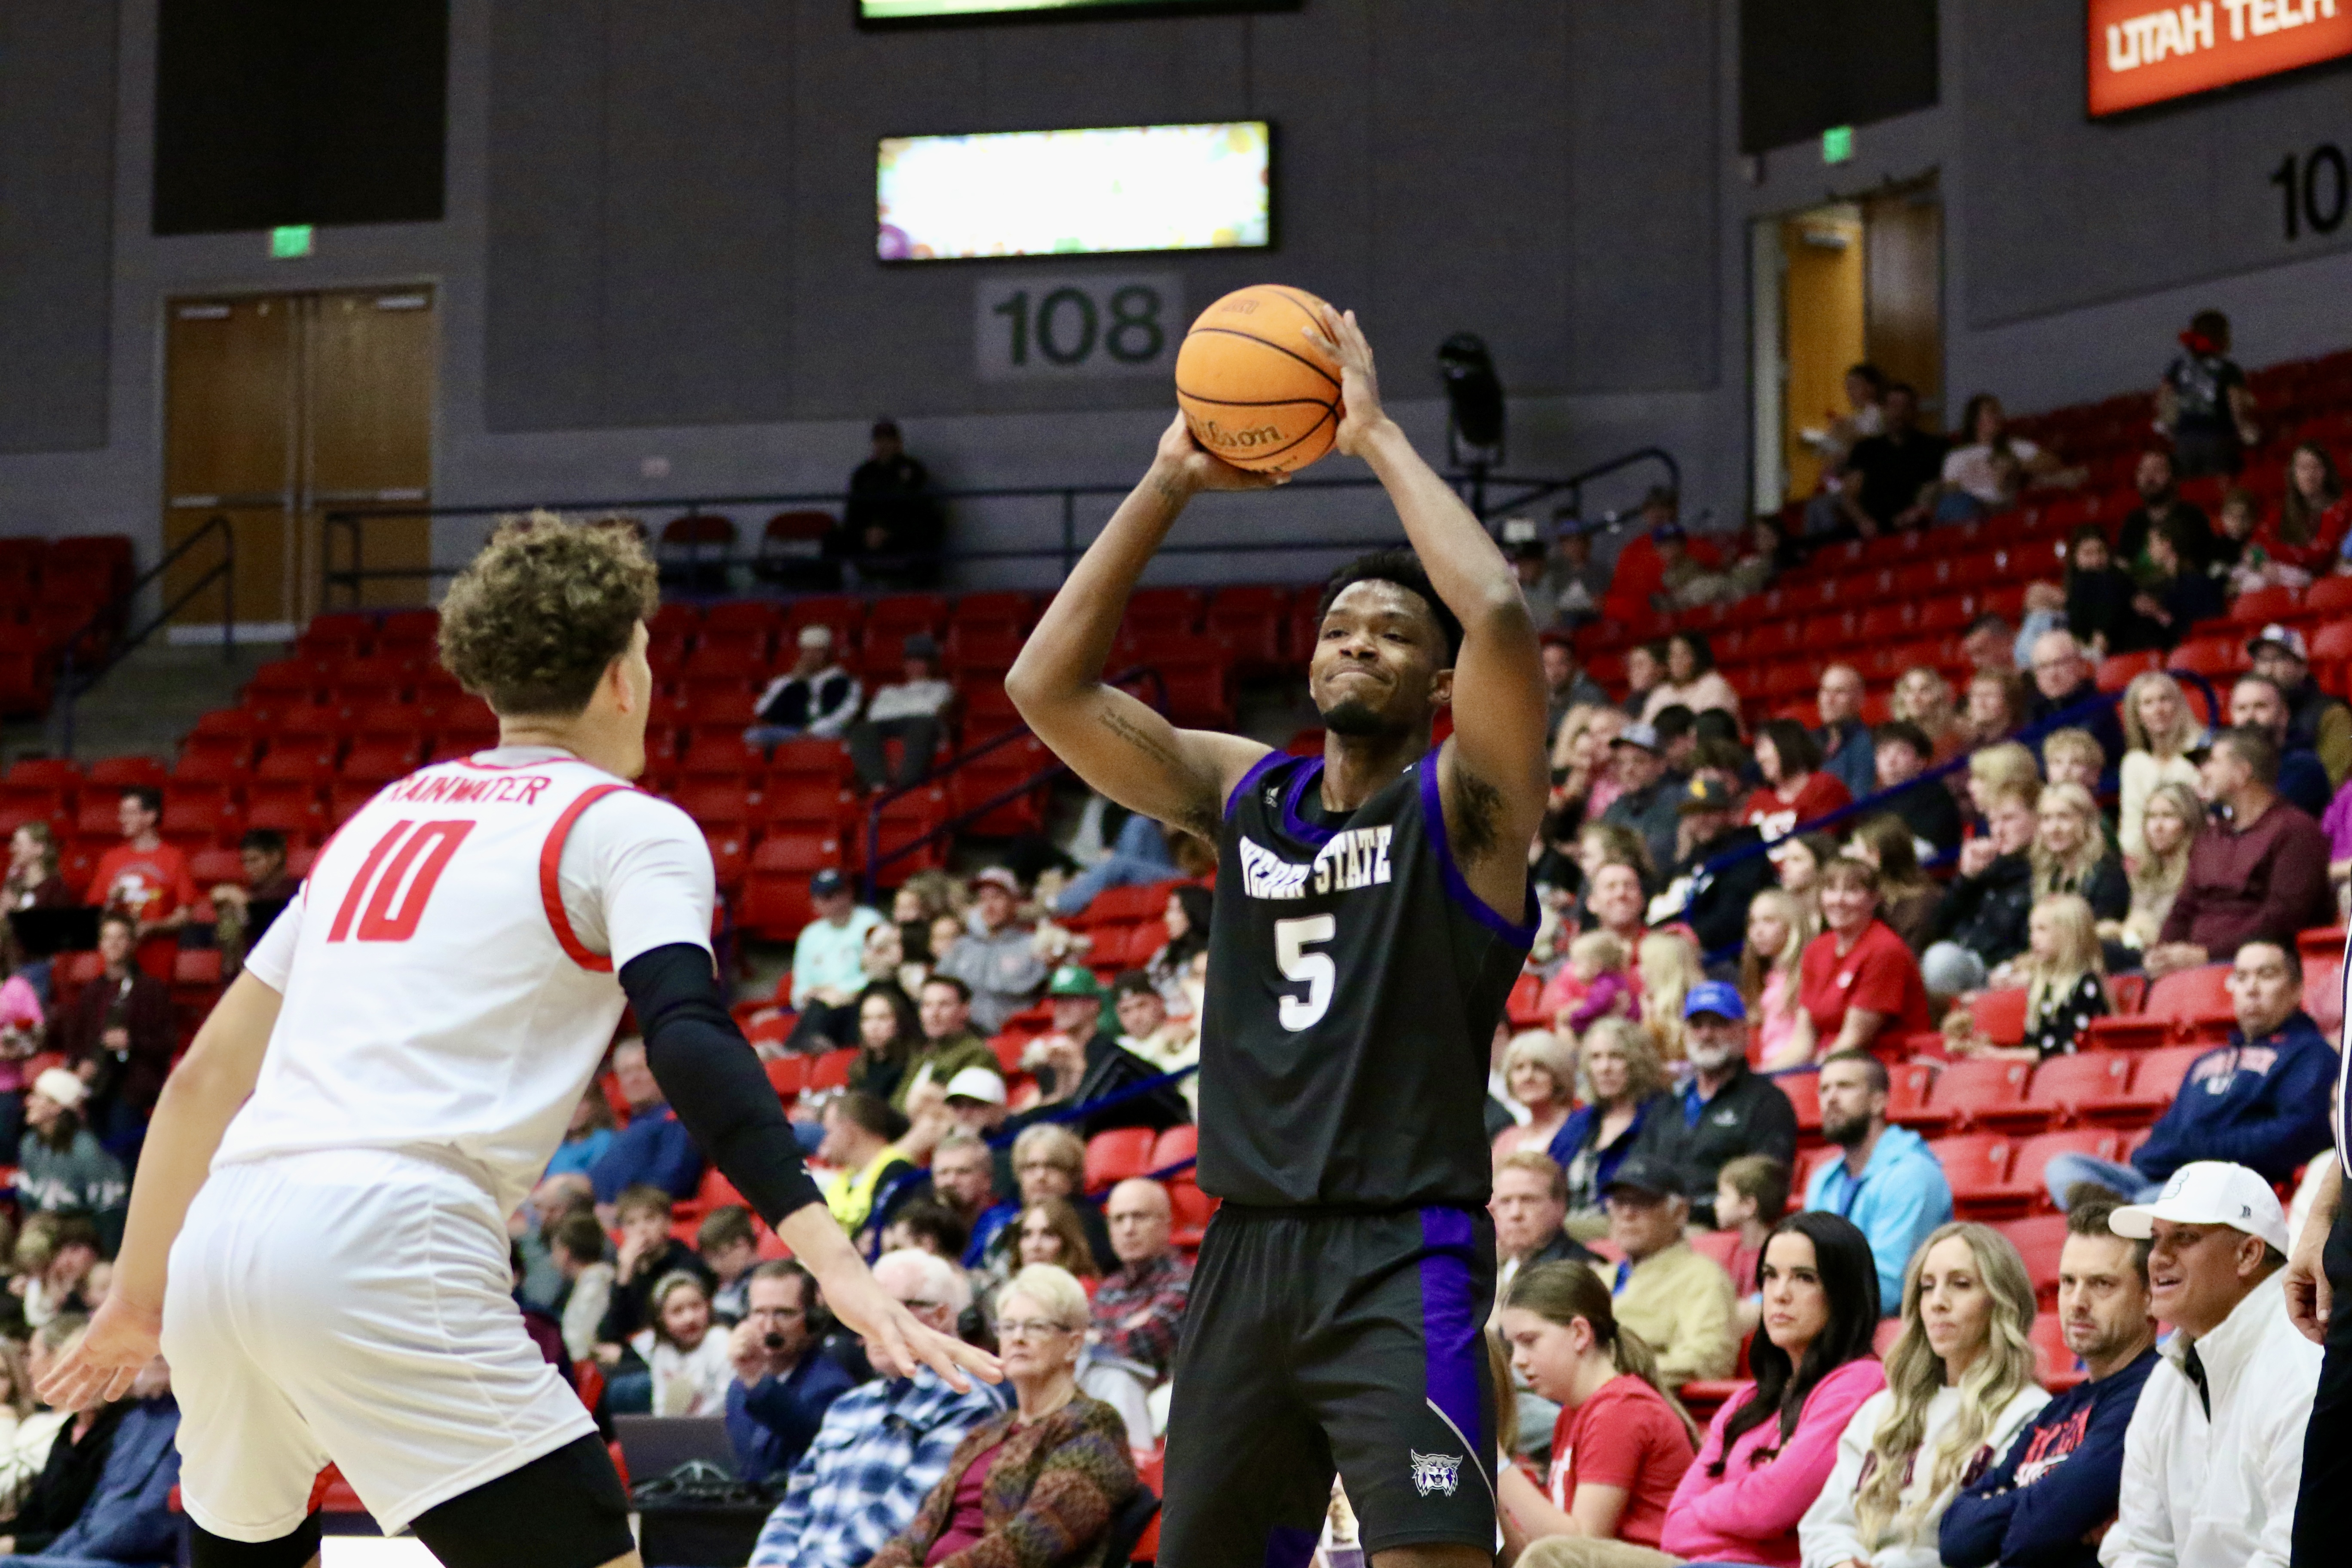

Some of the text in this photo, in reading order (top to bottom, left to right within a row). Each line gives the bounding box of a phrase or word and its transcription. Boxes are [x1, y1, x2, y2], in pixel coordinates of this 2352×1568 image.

[2107, 1, 2214, 71] UTAH
[995, 285, 1164, 364] 108
[327, 819, 477, 943] 10
[1313, 824, 1393, 895] STATE
[1274, 913, 1336, 1032] 5
